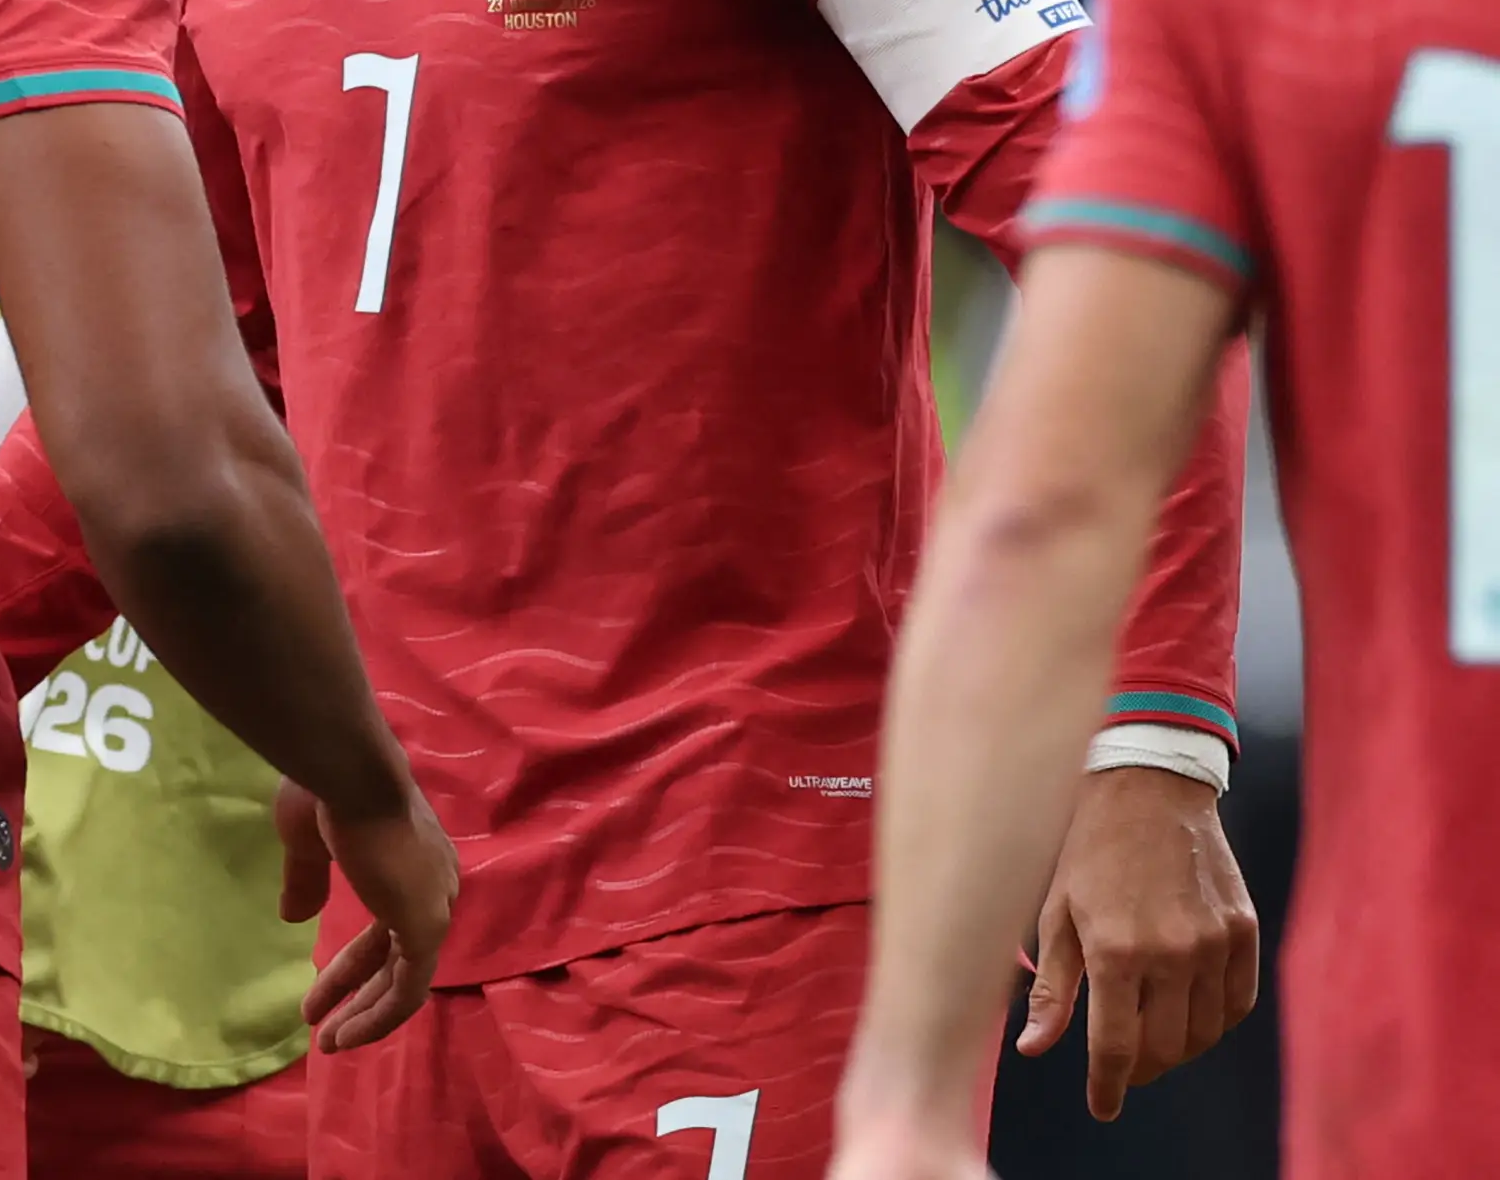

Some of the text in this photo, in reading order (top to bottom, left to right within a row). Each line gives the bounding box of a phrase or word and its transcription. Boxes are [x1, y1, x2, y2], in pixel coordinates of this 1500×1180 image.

[504, 12, 577, 30] HOUSTON
[342, 52, 419, 313] 7
[788, 776, 873, 790] ULTRAWEAVE
